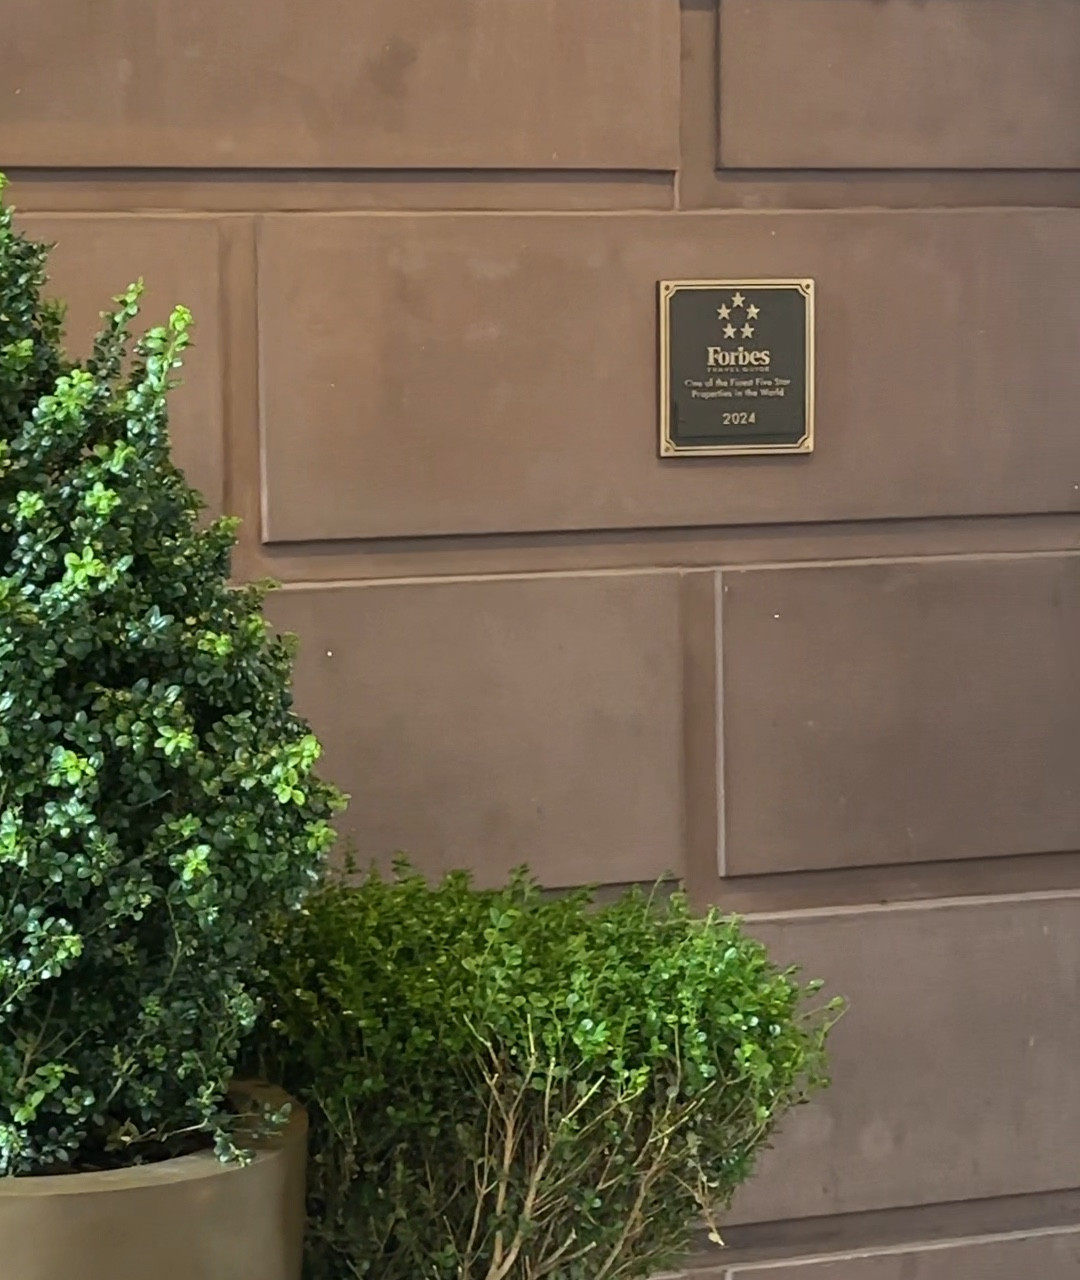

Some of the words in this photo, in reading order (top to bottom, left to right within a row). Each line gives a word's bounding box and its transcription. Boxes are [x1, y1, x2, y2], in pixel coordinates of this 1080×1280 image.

[706, 346, 771, 366] Forbes
[684, 379, 703, 388] One
[704, 378, 713, 387] of
[715, 378, 728, 387] the
[734, 389, 743, 397] in
[744, 388, 758, 397] the
[760, 388, 784, 397] World
[722, 412, 756, 425] 2024
